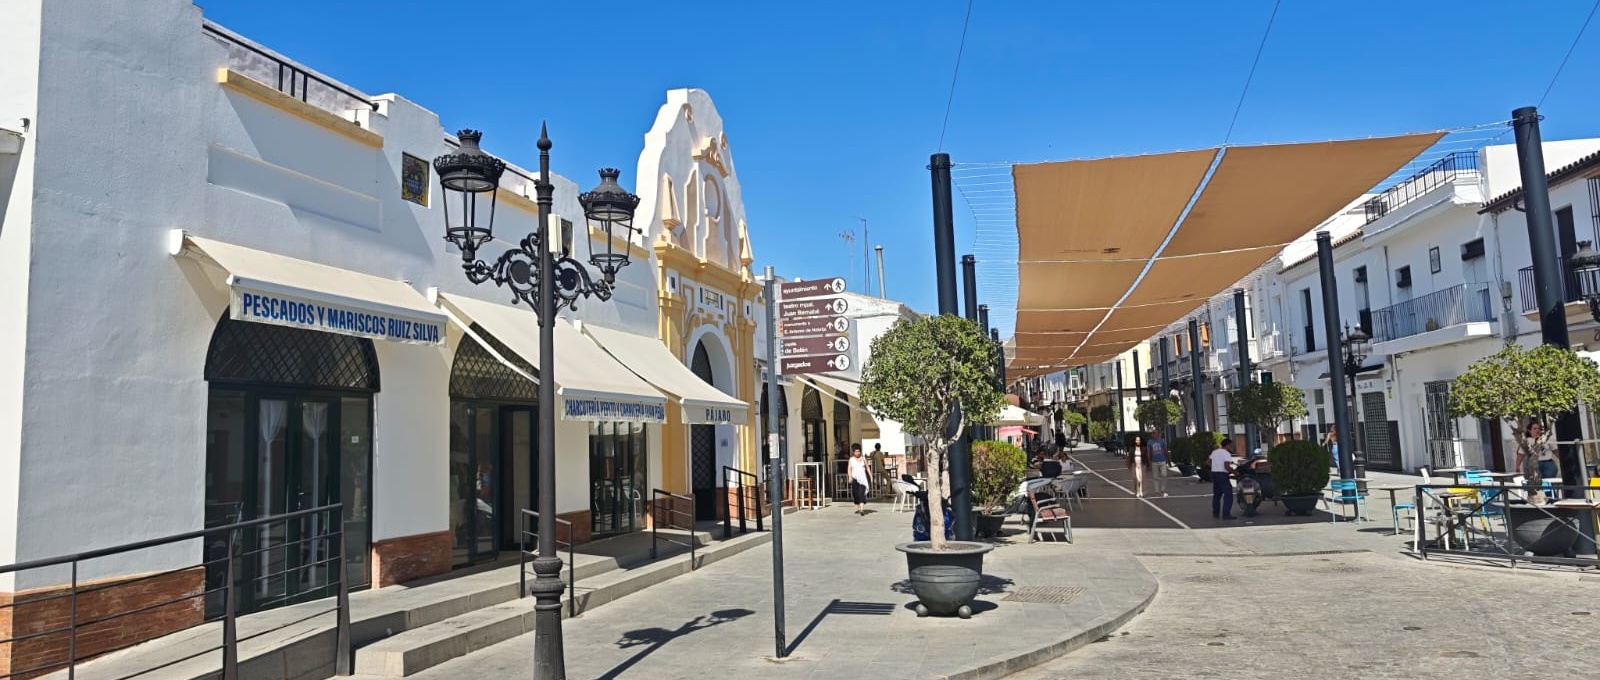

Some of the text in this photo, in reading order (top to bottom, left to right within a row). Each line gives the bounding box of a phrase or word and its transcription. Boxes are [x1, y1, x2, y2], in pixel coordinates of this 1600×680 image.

[783, 285, 818, 294] ayuntamiento
[243, 292, 439, 343] PESCADOS Y MARISCOS RUIZ SILVA
[786, 361, 811, 369] juzgados
[565, 398, 600, 416] CHARCUTERÍA
[705, 406, 731, 421] PÁJARO
